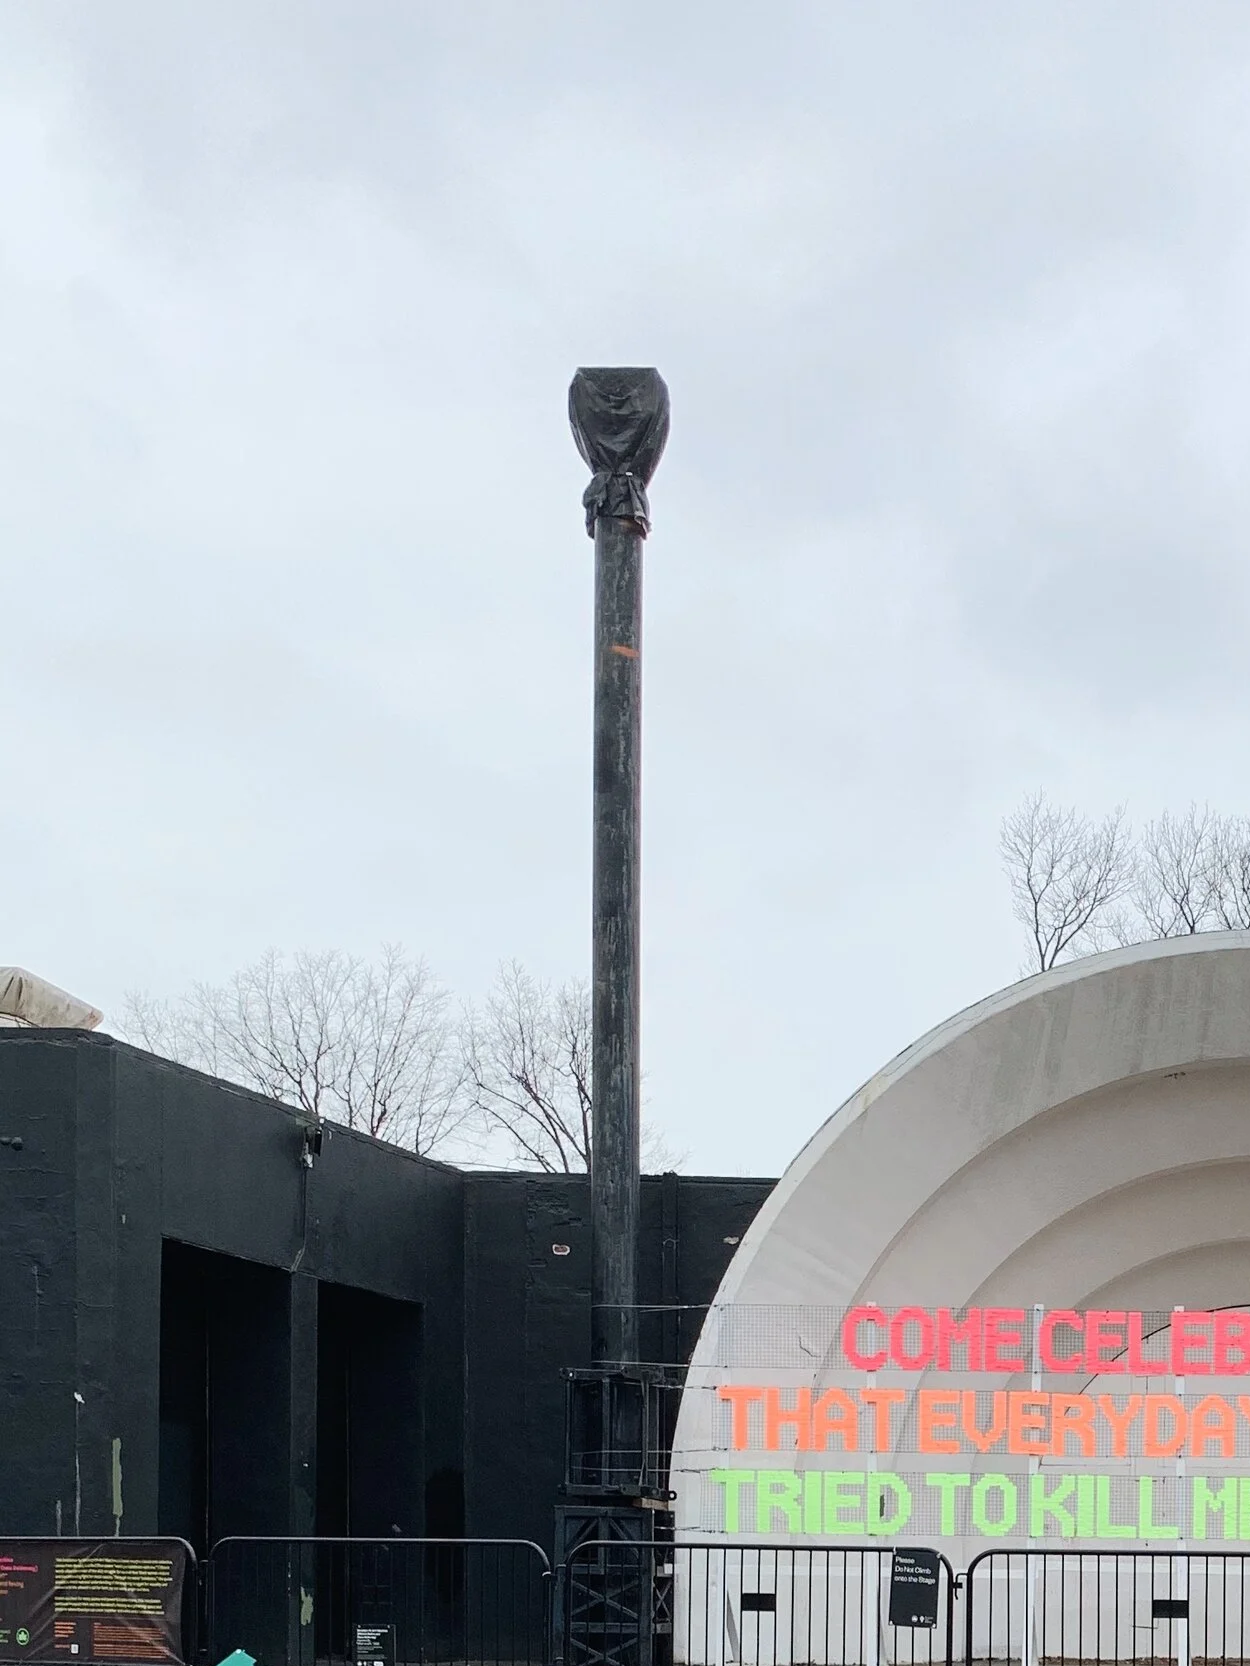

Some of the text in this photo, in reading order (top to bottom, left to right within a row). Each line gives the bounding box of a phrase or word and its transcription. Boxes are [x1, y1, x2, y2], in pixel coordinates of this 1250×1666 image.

[842, 1306, 1025, 1372] COME
[718, 1386, 905, 1452] THAT
[711, 1470, 912, 1536] TRIED
[926, 1473, 1018, 1537] TO
[1031, 1474, 1180, 1539] KILL
[915, 1566, 931, 1574] Climb
